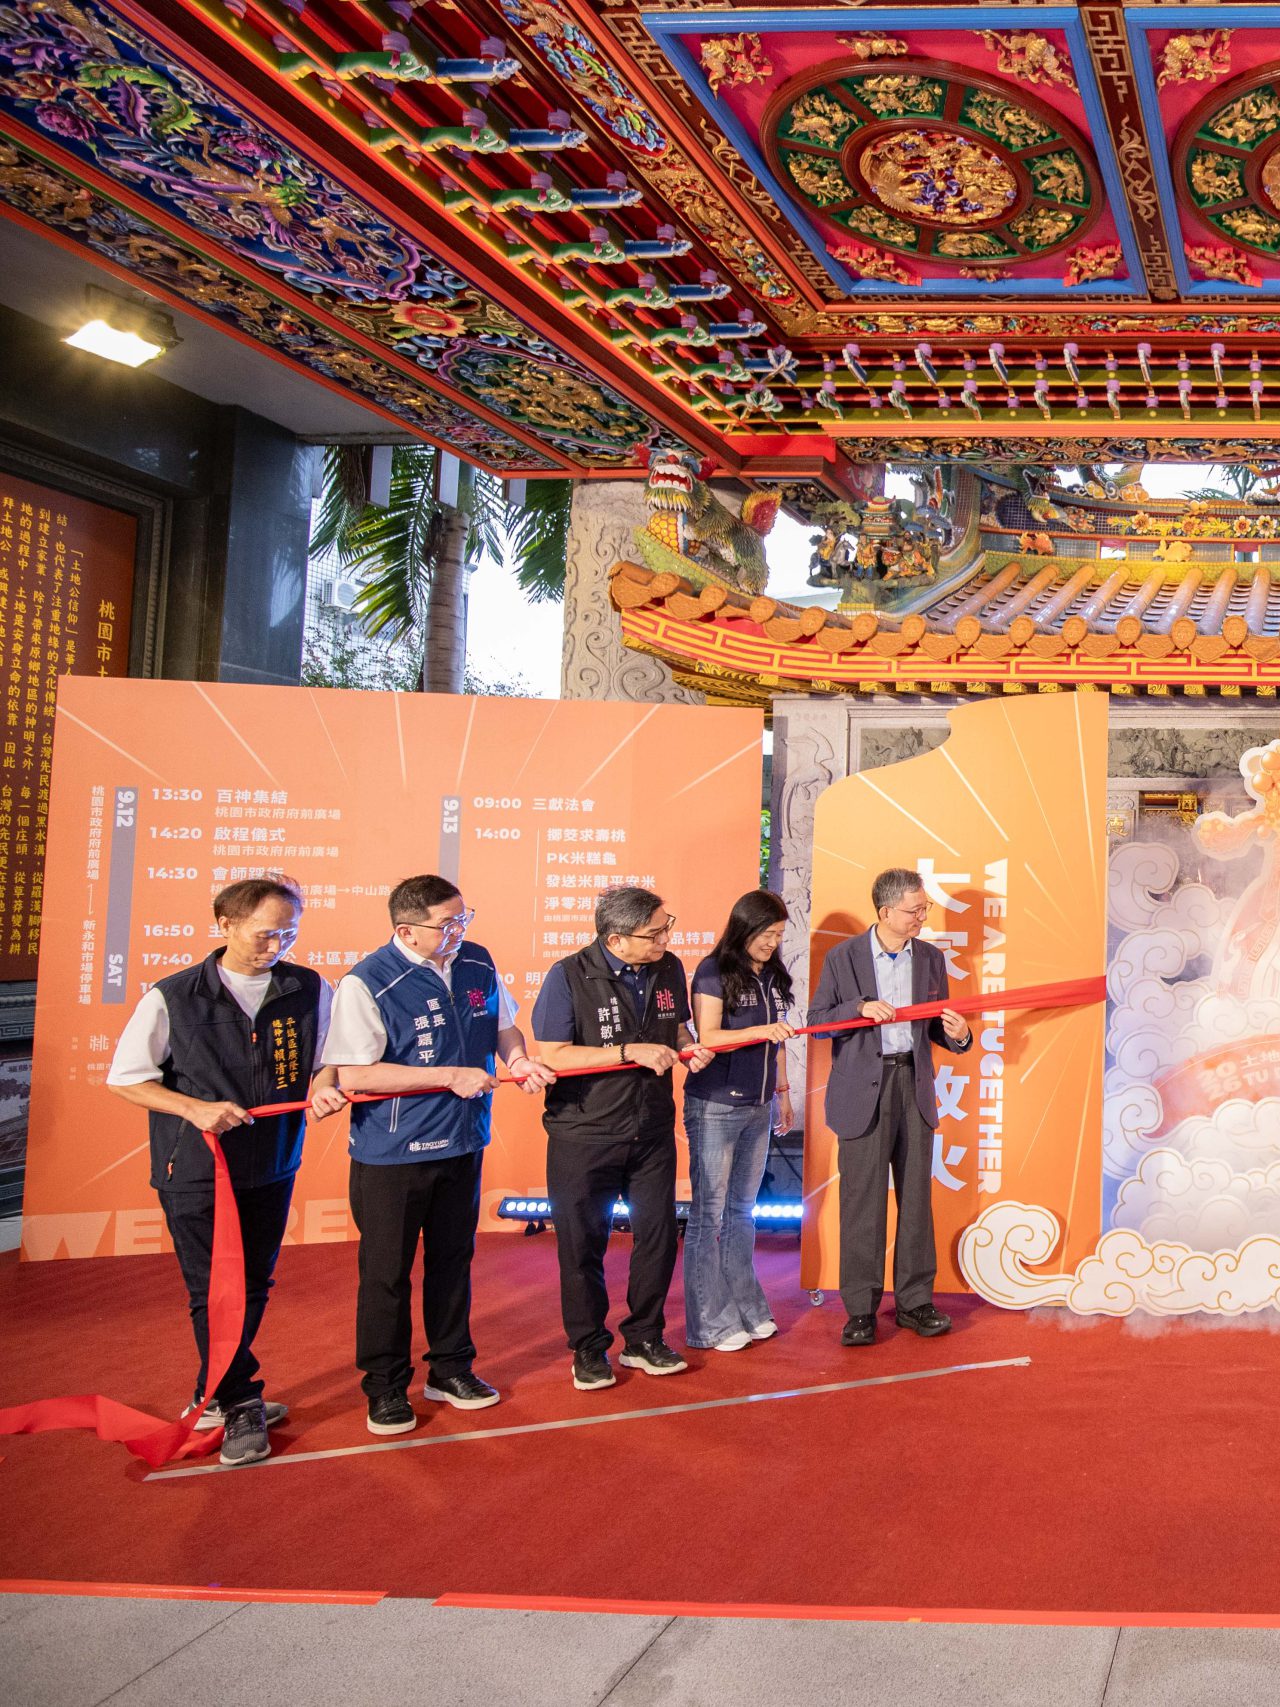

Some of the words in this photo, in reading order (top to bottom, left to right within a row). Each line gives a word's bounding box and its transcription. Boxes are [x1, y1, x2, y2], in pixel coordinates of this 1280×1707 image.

[152, 788, 203, 801] 13:30
[216, 789, 289, 805] 百神集結
[473, 796, 522, 809] 09:00
[532, 798, 595, 812] 三獻法會
[116, 790, 135, 828] 9.12
[214, 806, 342, 820] 桃園市政府府前廣場
[442, 799, 460, 834] 9.13
[86, 785, 105, 880] 桃園市政府府前廣場
[149, 827, 203, 840] 14:20
[475, 828, 521, 840] 14:00
[212, 844, 339, 858] 桃園市政府府前廣場
[147, 867, 198, 880] 14:30
[983, 858, 1008, 918] WE
[144, 925, 195, 938] 16:50
[142, 953, 193, 965] 17:40
[107, 953, 124, 987] SAT
[426, 998, 446, 1028] 區長
[414, 1015, 435, 1064] 張嘉平
[1243, 1066, 1270, 1086] TU
